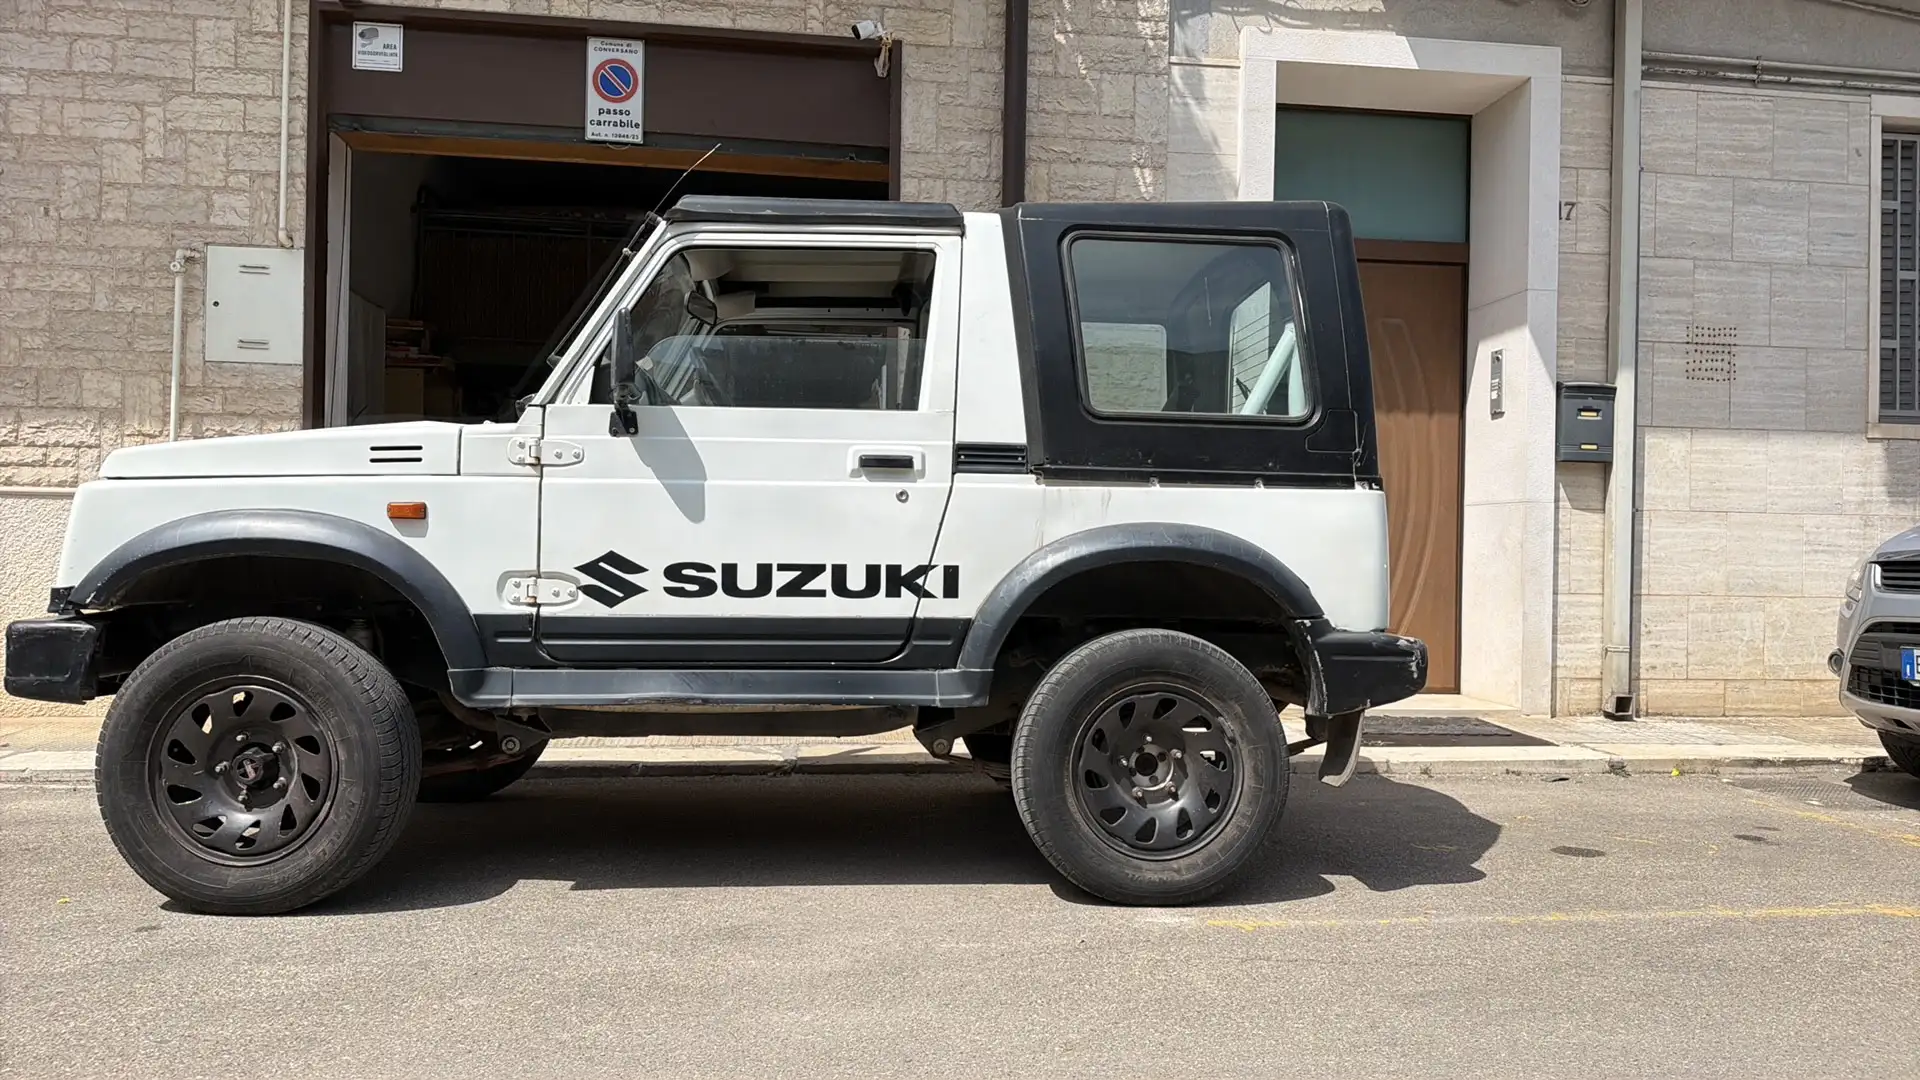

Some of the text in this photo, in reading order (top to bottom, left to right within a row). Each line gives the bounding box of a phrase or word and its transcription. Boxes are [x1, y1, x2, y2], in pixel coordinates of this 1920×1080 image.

[593, 46, 639, 54] CONVERSANO
[598, 107, 631, 116] passo
[589, 118, 641, 129] carrabile
[662, 561, 960, 599] SUZUKI
